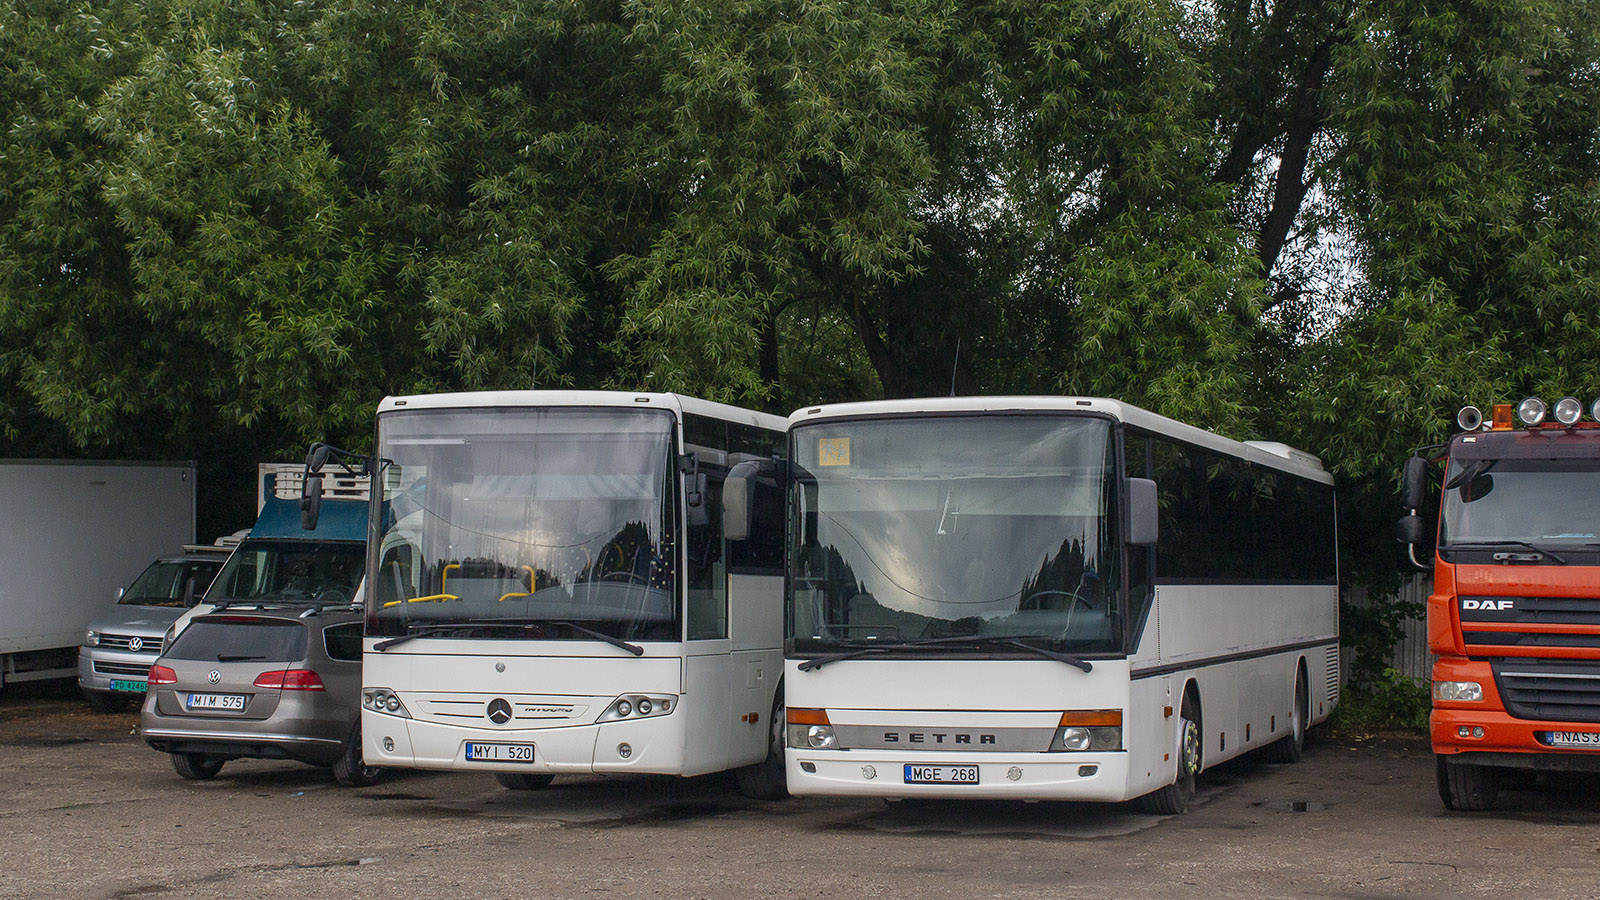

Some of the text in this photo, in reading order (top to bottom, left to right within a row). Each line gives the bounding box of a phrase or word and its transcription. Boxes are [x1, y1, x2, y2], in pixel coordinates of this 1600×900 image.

[1462, 600, 1514, 610] DAF
[193, 695, 242, 708] MIM 575
[884, 732, 996, 744] SETRA
[474, 745, 531, 759] MYI 520
[913, 767, 976, 781] MGE 268
